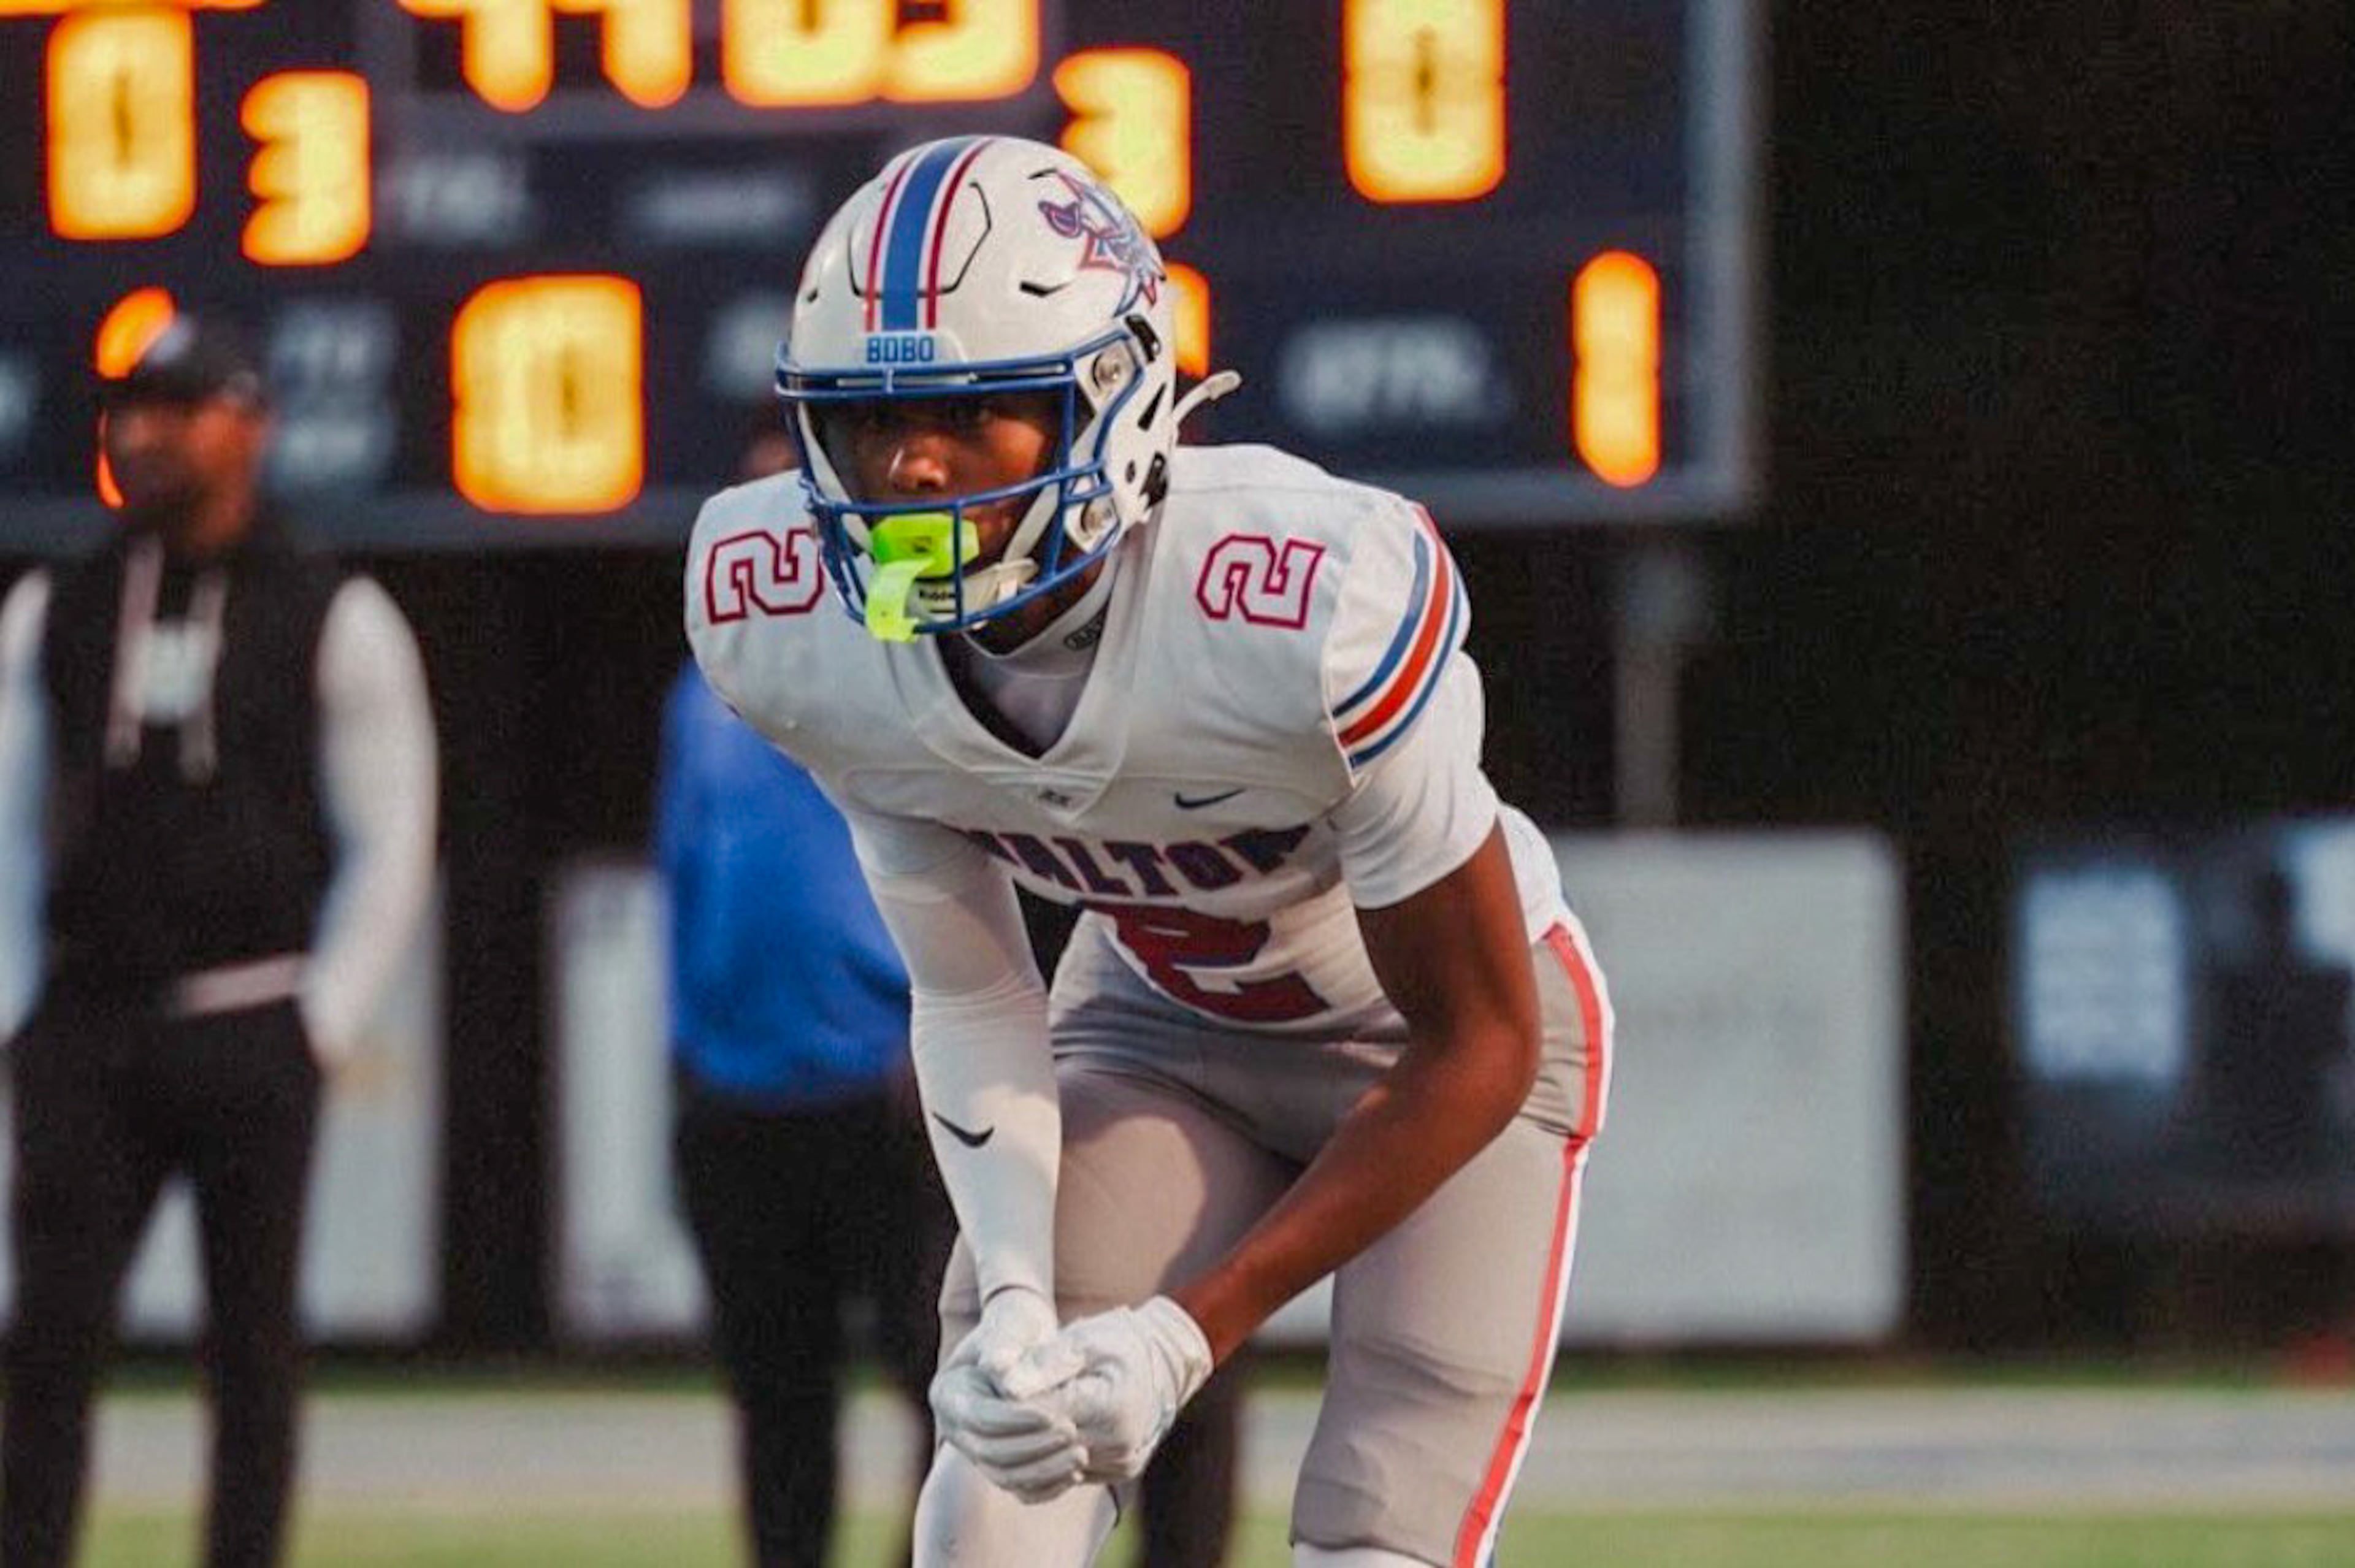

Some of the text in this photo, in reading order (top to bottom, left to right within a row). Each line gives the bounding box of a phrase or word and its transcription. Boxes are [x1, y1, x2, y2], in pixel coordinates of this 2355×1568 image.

[240, 71, 372, 266] 3
[867, 337, 934, 363] BOBO
[707, 529, 822, 624] 2
[1196, 532, 1327, 630] 2
